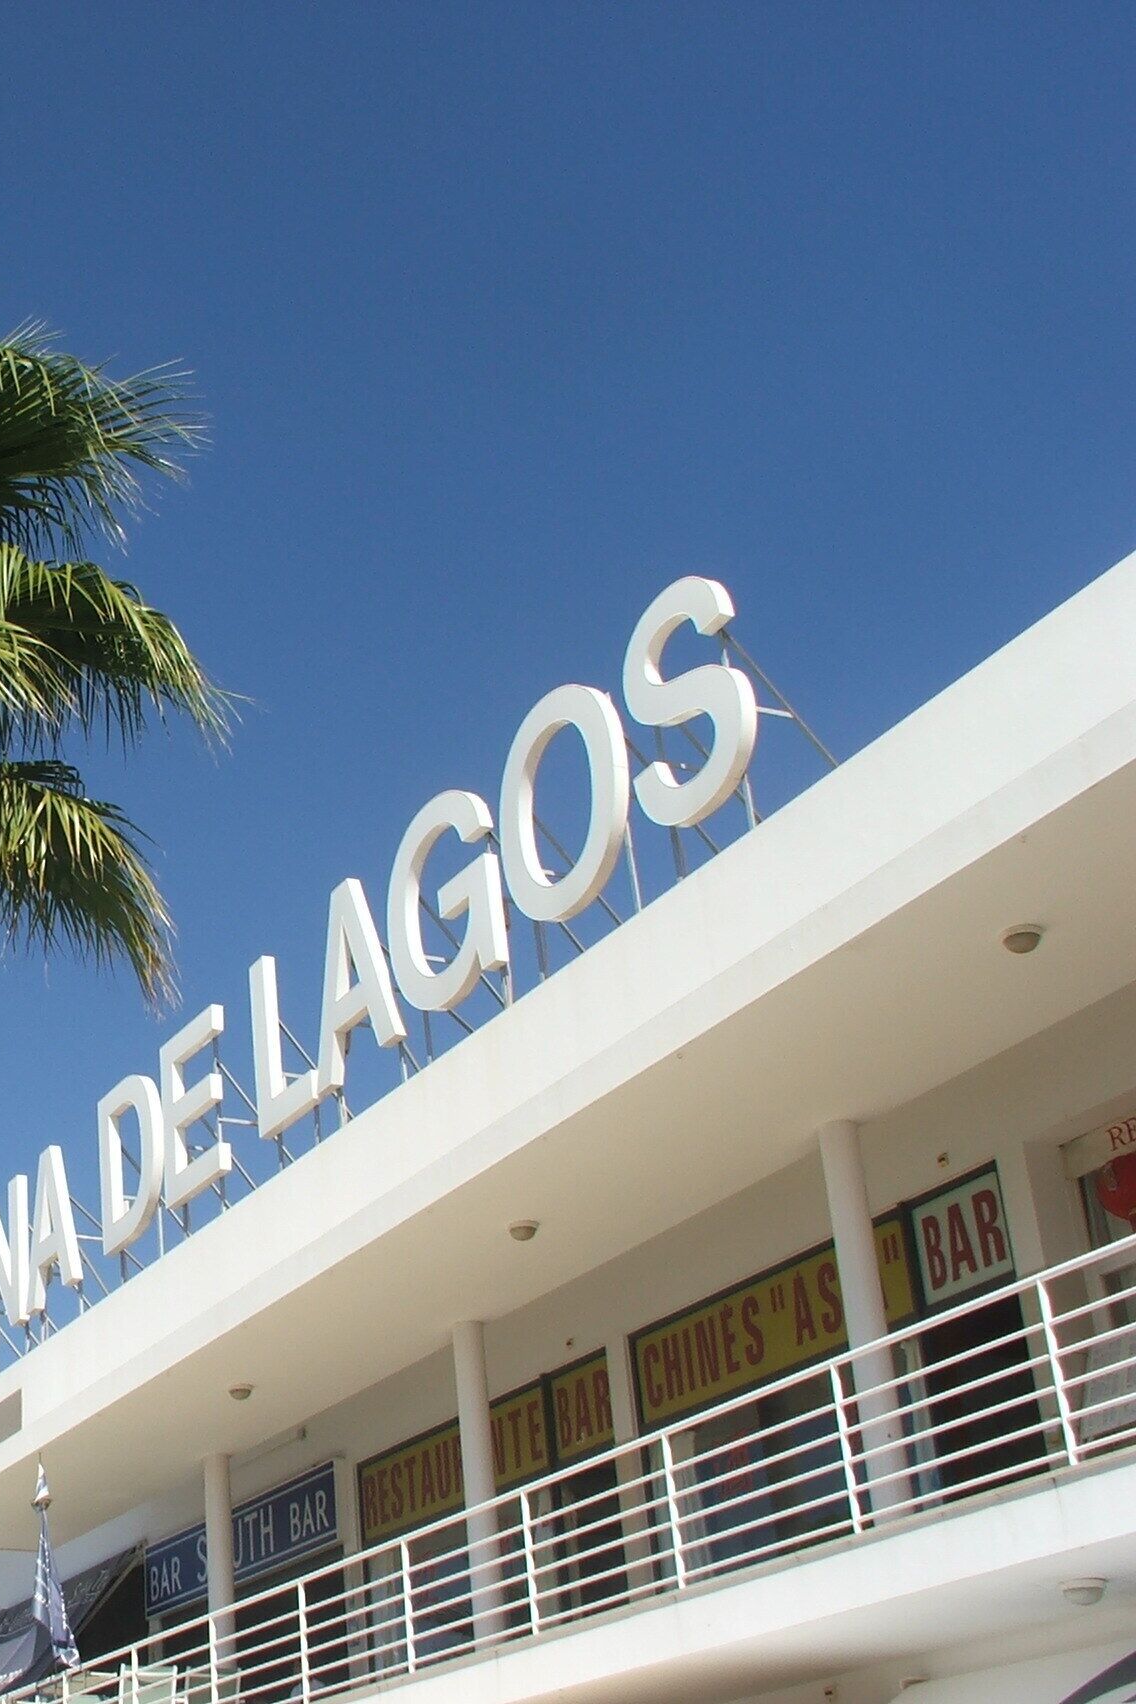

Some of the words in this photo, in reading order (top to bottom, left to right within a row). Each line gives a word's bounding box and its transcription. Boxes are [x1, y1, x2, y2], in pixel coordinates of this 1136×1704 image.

[97, 1003, 232, 1256] DE
[249, 576, 757, 1140] LAGOS
[921, 1189, 1007, 1291] BAR
[363, 1401, 544, 1530] RESTAURNTE
[556, 1369, 613, 1449] BAR
[150, 1556, 182, 1602] BAR
[197, 1505, 275, 1583] SUTH
[290, 1490, 329, 1542] BAR
